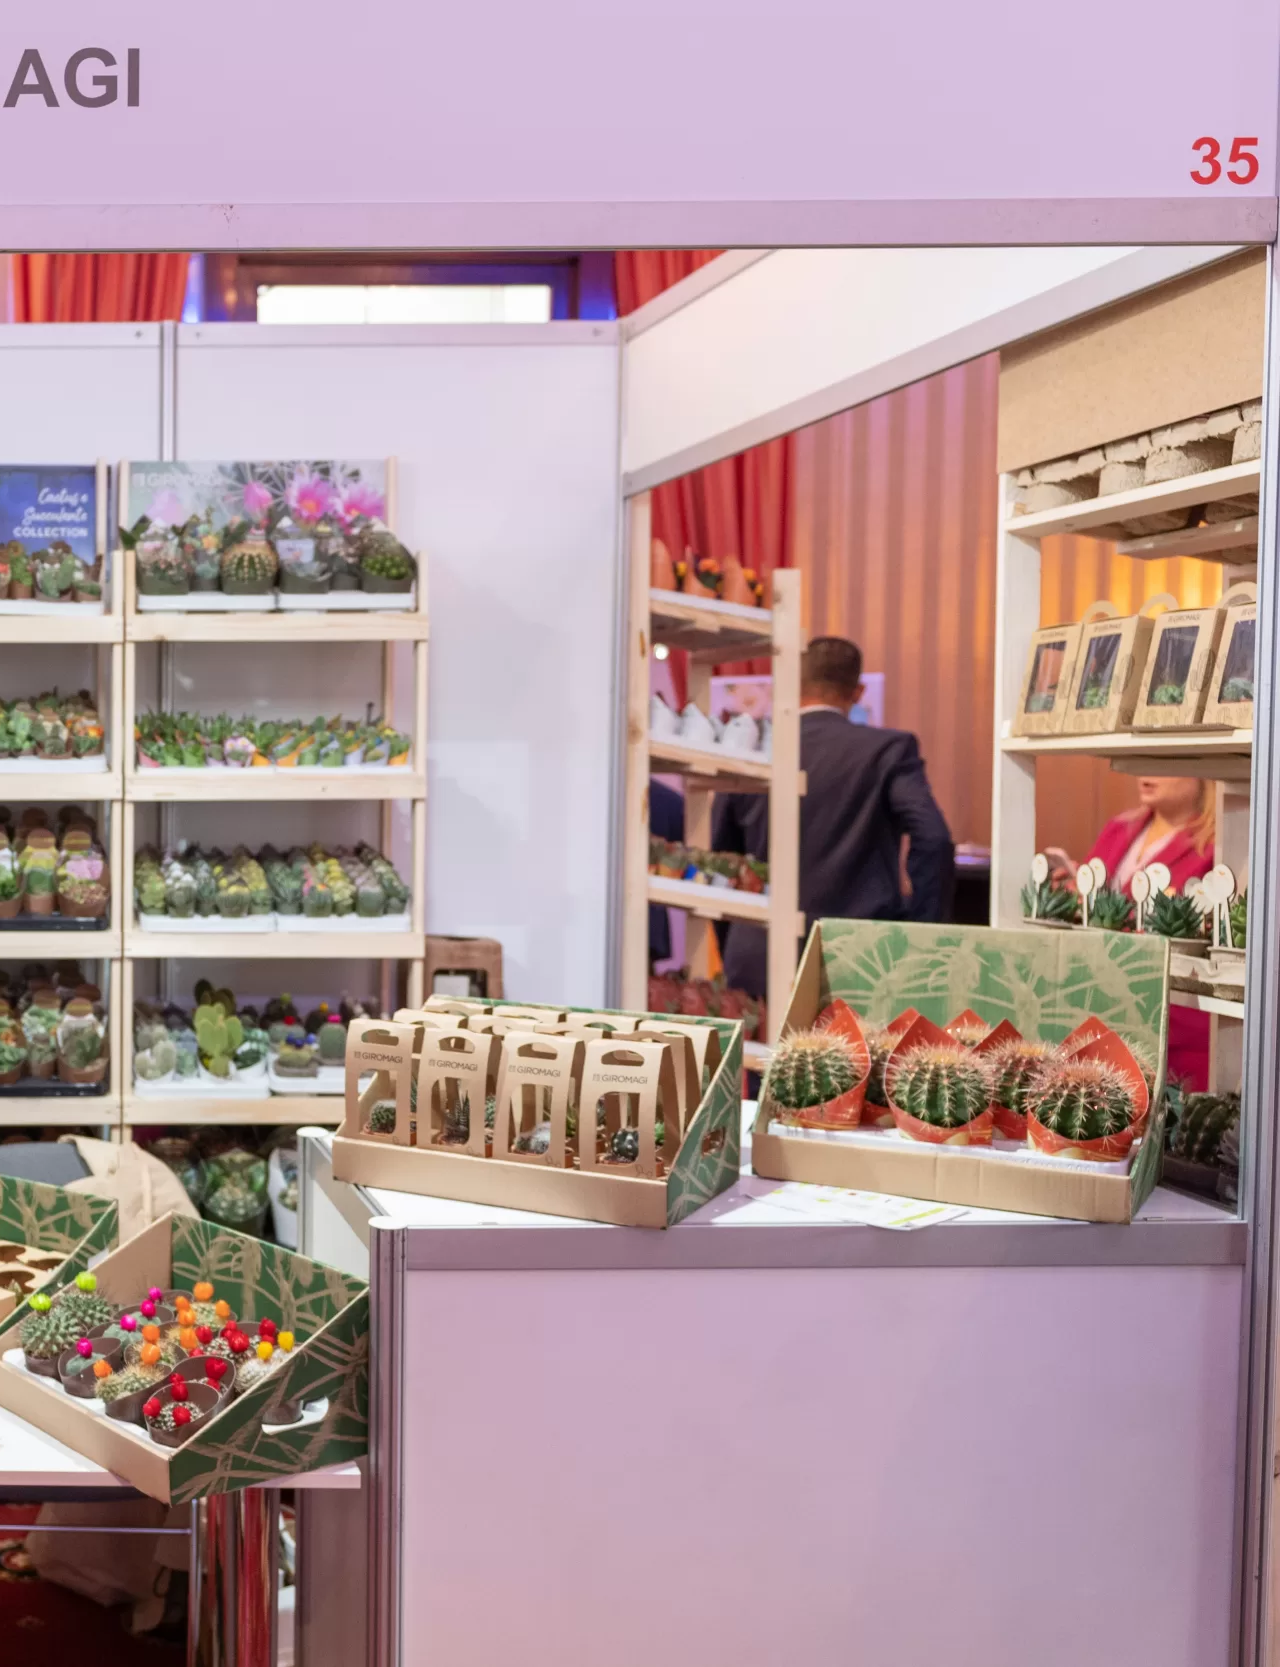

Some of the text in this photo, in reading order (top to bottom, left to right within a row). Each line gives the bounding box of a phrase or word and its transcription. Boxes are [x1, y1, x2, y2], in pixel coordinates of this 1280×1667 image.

[1190, 136, 1259, 185] 35
[12, 527, 88, 538] COLLECTION
[361, 1051, 403, 1064] GIROMAGI
[436, 1059, 478, 1072] GIROMAGI
[516, 1065, 561, 1078] GIROMAGI
[601, 1073, 648, 1085] GIROMAGI
